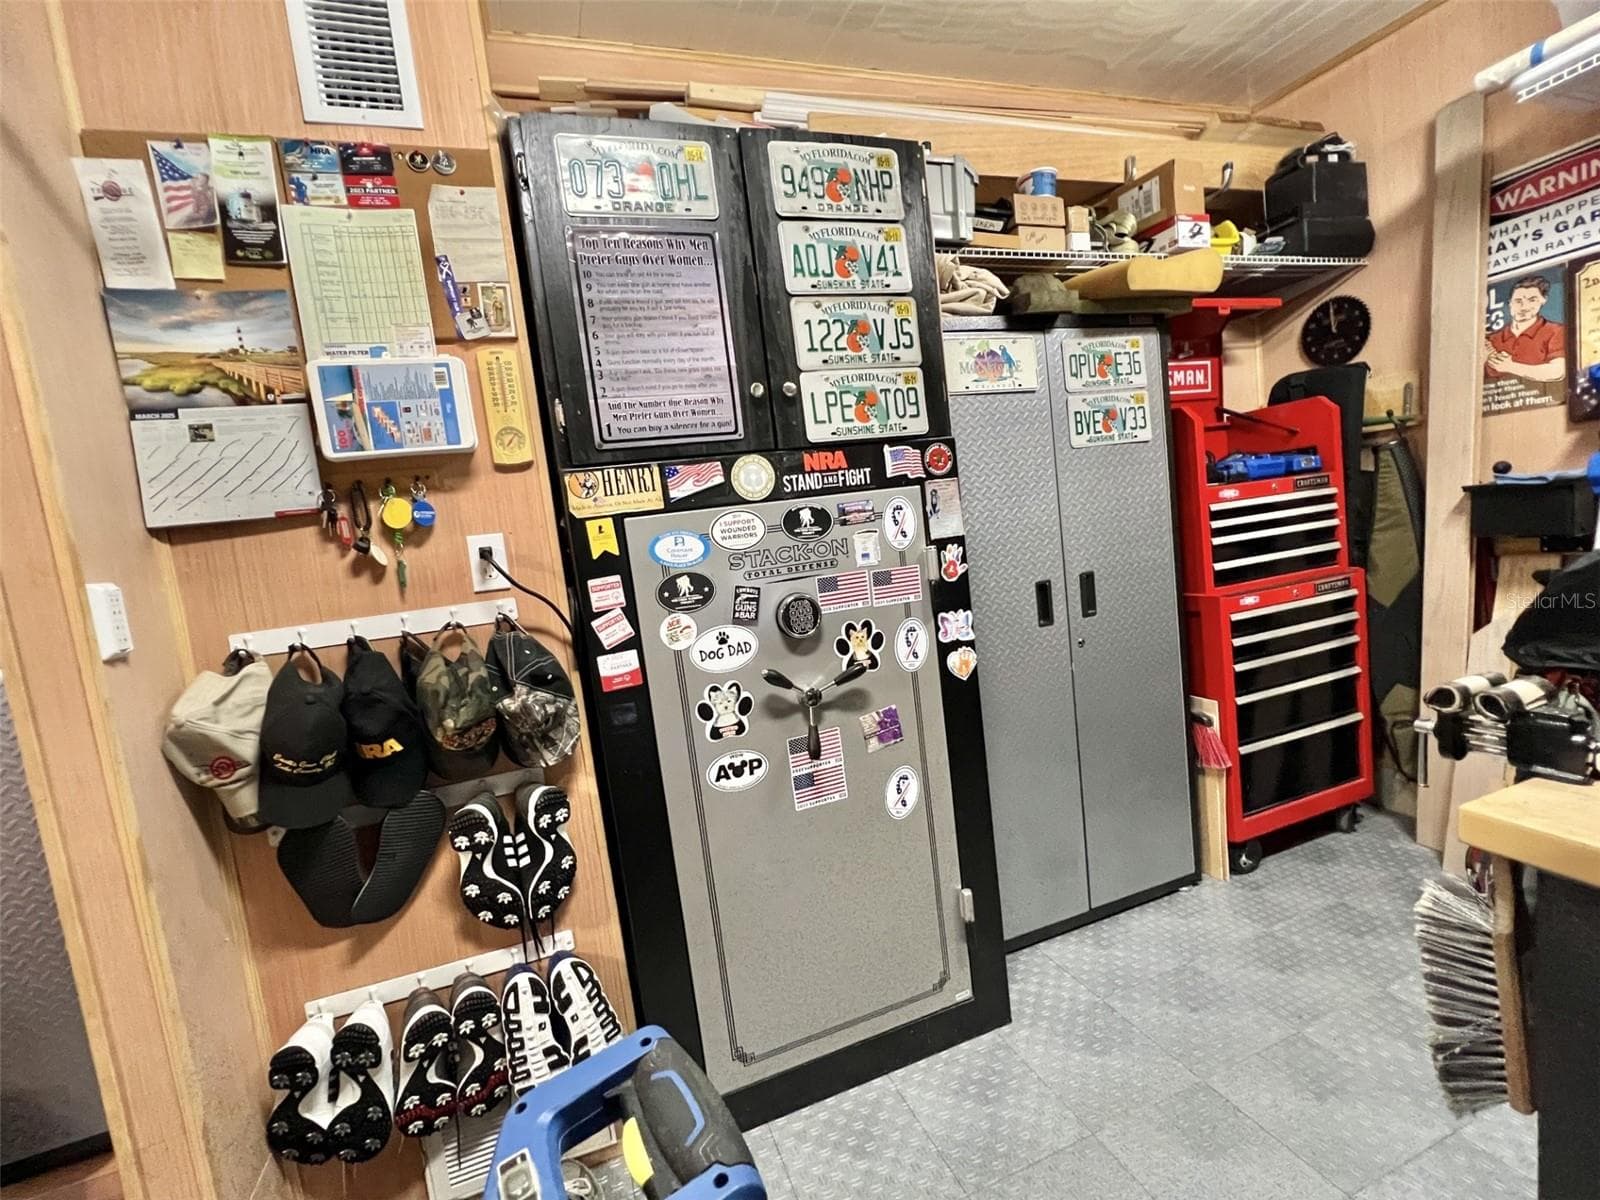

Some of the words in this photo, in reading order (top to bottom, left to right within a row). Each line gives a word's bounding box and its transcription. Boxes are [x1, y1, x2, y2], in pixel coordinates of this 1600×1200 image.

[800, 149, 871, 164] MYFLORIDA.COM
[568, 158, 625, 198] 073
[781, 165, 826, 199] 949
[854, 168, 893, 202] NHP
[612, 201, 675, 213] ORANGE
[818, 203, 869, 213] ORANGE
[808, 226, 880, 241] MYFLORIDA.COM
[580, 239, 599, 250] Top
[603, 239, 620, 249] Ten
[623, 238, 663, 249] Reasons
[666, 238, 686, 250] Why
[690, 239, 708, 250] Men
[1525, 247, 1539, 257] IN
[1545, 231, 1591, 252] RAY'S
[580, 254, 612, 265] Prefer
[615, 254, 640, 266] Guns
[642, 254, 664, 266] Over
[793, 244, 834, 278] AQJ
[861, 244, 902, 278] V41
[583, 270, 592, 279] 10
[585, 283, 592, 292] 9
[817, 280, 857, 289] SUNSHINE
[860, 280, 885, 289] STATE
[587, 299, 594, 308] 8
[821, 301, 890, 315] MYFLORIDA.COM
[589, 316, 596, 325] 7
[592, 331, 599, 340] 6
[804, 319, 847, 352] 122
[873, 318, 914, 350] VJS
[595, 359, 602, 367] 4
[828, 355, 868, 364] SUNSHINE
[872, 353, 895, 363] STATE
[1114, 351, 1142, 376] E36
[598, 371, 604, 380] 3
[829, 373, 898, 387] MYFLORIDA.COM
[600, 387, 608, 398] 2
[608, 402, 622, 411] And
[624, 401, 637, 410] The
[639, 399, 666, 408] Number
[669, 398, 682, 407] One
[684, 397, 709, 406] Reason
[710, 396, 724, 405] Why
[811, 391, 854, 424] LPE
[1491, 400, 1512, 411] look
[1513, 398, 1523, 408] at
[613, 413, 627, 422] Men
[629, 412, 652, 421] Prefer
[654, 410, 671, 419] Guns
[673, 409, 689, 418] Over
[1074, 410, 1102, 436] BVE
[1120, 406, 1147, 431] V33
[605, 423, 612, 437] 1
[617, 425, 632, 435] You
[649, 424, 662, 433] buy
[670, 421, 698, 430] silencer
[700, 420, 709, 429] for
[717, 419, 732, 429] gun!
[836, 425, 875, 436] SUNSHINE
[879, 423, 902, 433] STATE
[803, 450, 848, 471] NRA
[602, 466, 657, 497] HENRY
[783, 472, 823, 493] STAND
[824, 475, 838, 485] AND
[838, 468, 871, 487] FIGHT
[1296, 477, 1329, 488] CRAFTSMAN
[724, 518, 755, 527] SUPPORT
[720, 525, 757, 534] WOUNDED
[720, 532, 758, 541] WARRIORS
[728, 538, 849, 571] STACK-ON
[747, 568, 782, 579] TOTAL
[787, 560, 835, 573] DEFENSE
[1318, 579, 1350, 592] CRAFTSMAN
[735, 604, 757, 612] GUNS
[699, 647, 725, 662] DOG
[728, 641, 752, 657] DAD
